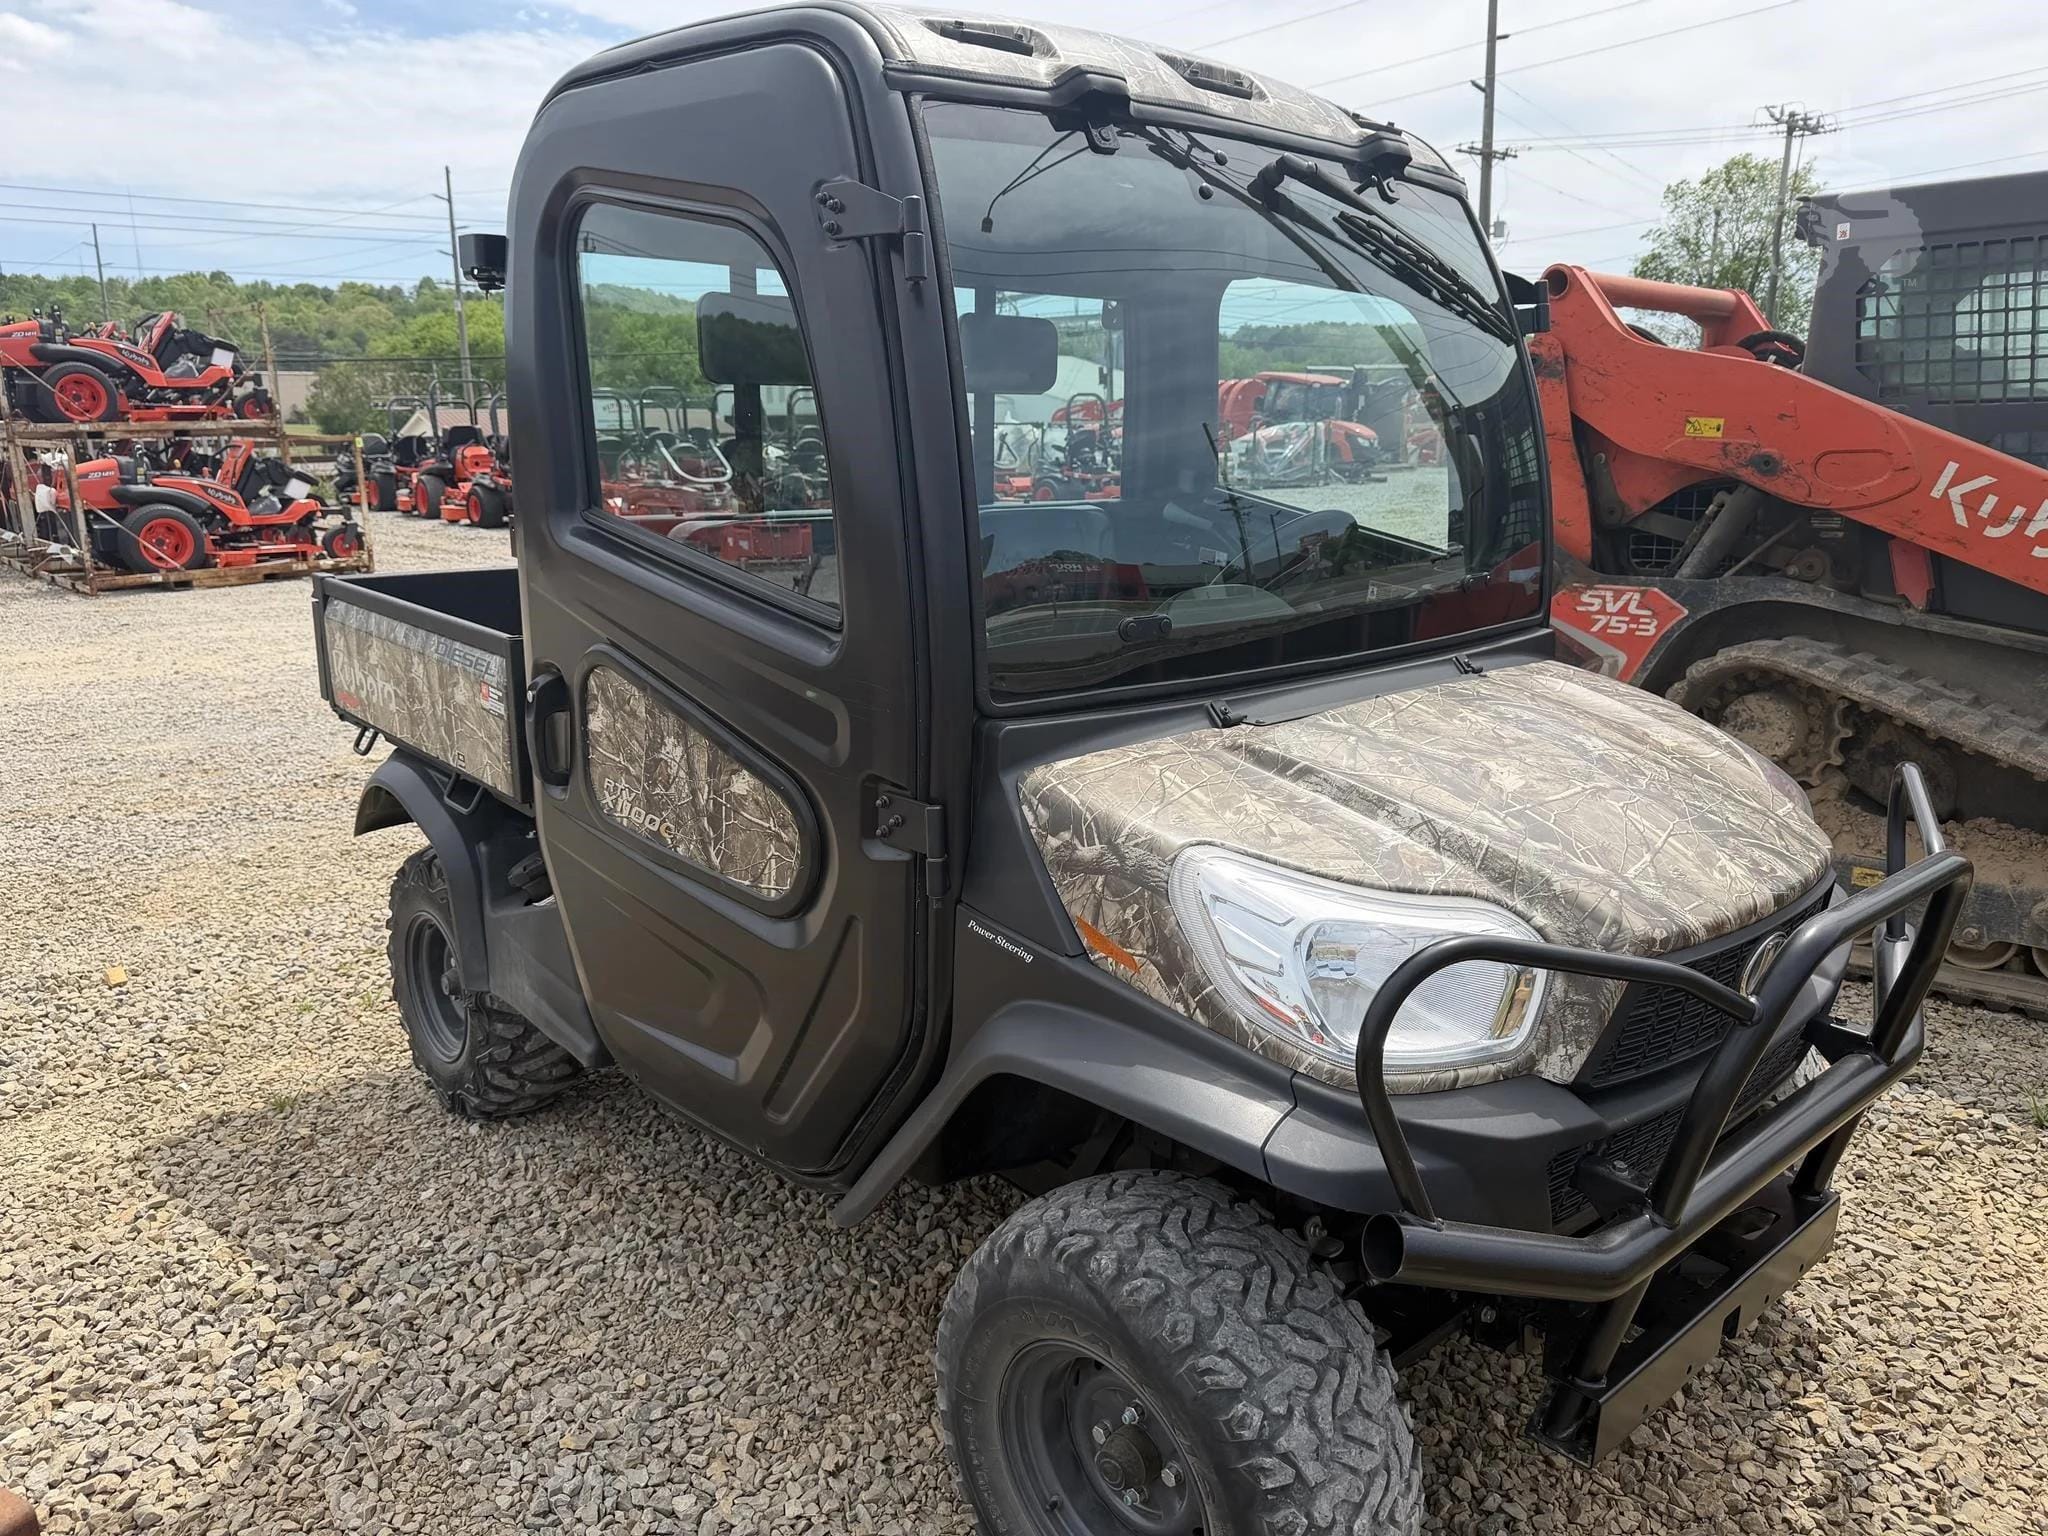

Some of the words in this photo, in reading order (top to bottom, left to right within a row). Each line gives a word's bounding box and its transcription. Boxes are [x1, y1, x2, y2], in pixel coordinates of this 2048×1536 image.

[1575, 589, 1653, 616] SVL
[1589, 614, 1659, 637] 75-3
[435, 642, 496, 677] DIESEL
[604, 778, 636, 802] RTV
[967, 919, 996, 941] Power
[995, 935, 1034, 964] Steering
